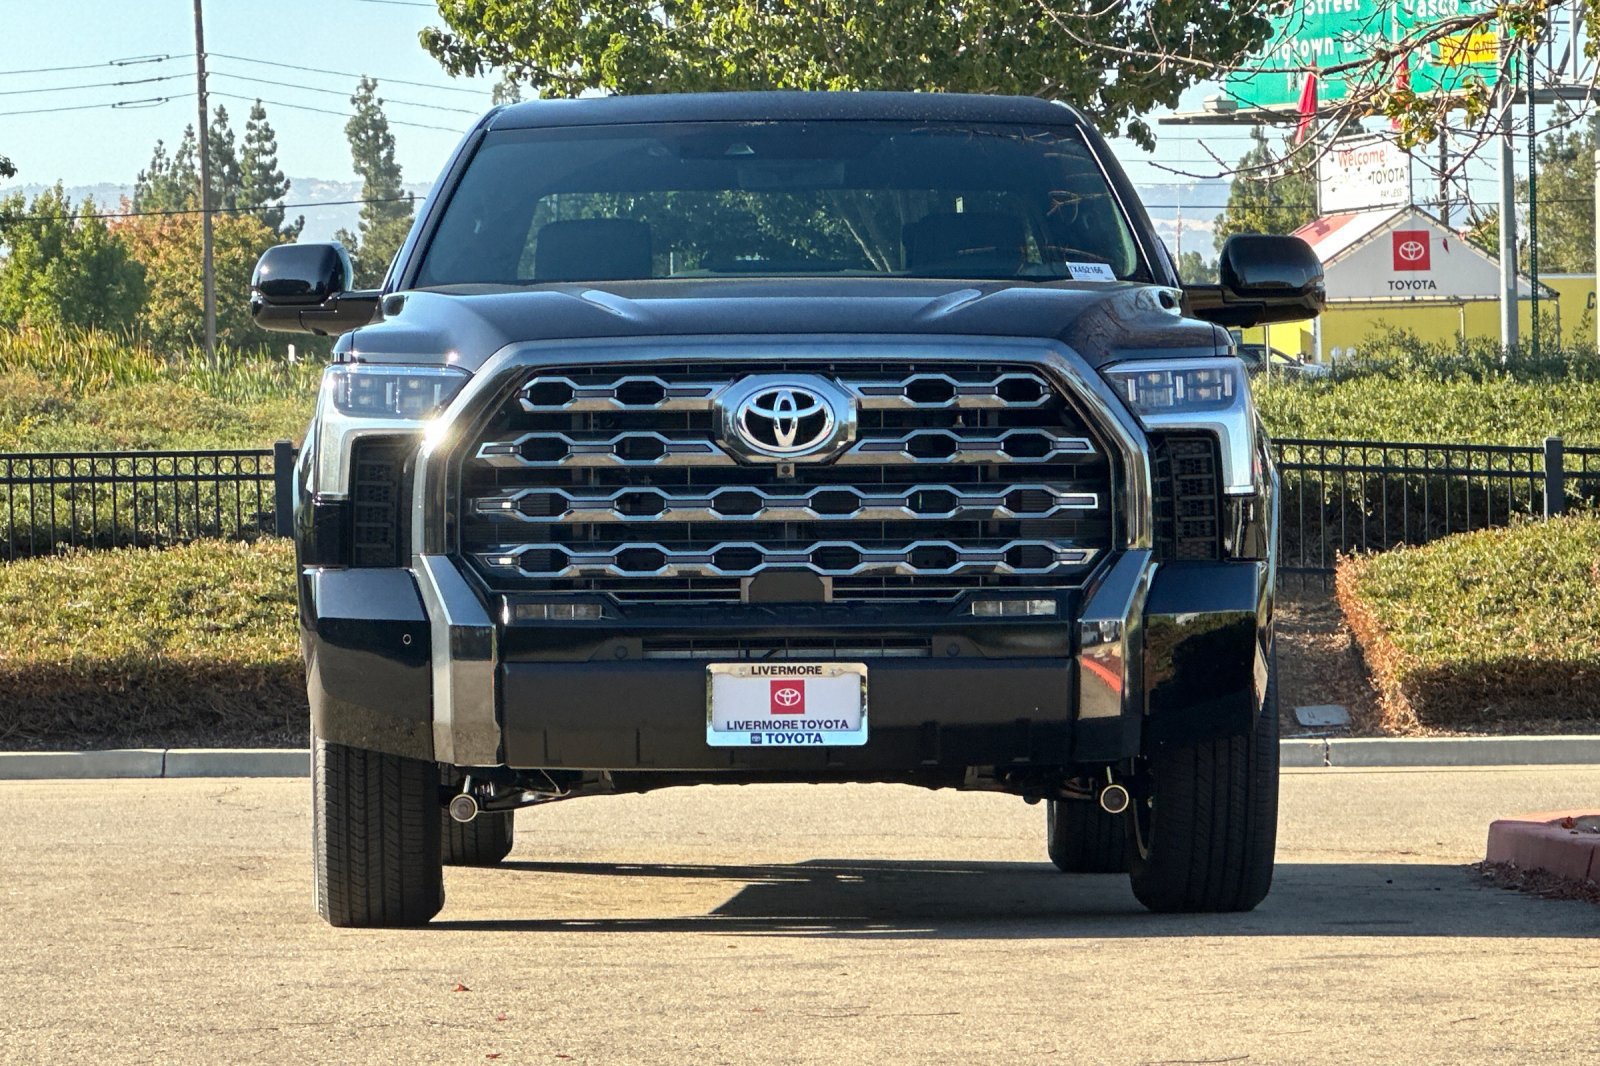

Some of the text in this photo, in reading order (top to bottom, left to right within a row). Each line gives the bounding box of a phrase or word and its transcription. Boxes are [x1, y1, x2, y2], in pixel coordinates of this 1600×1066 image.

[1403, 0, 1459, 18] Vasco
[1338, 144, 1389, 168] Welcome!
[1371, 167, 1405, 185] TOYOTA
[1387, 279, 1437, 291] TOYOTA
[751, 665, 823, 675] LIVERMORE
[726, 719, 849, 730] LIVERMORE TOYOTA
[766, 732, 823, 744] TOYOTA
